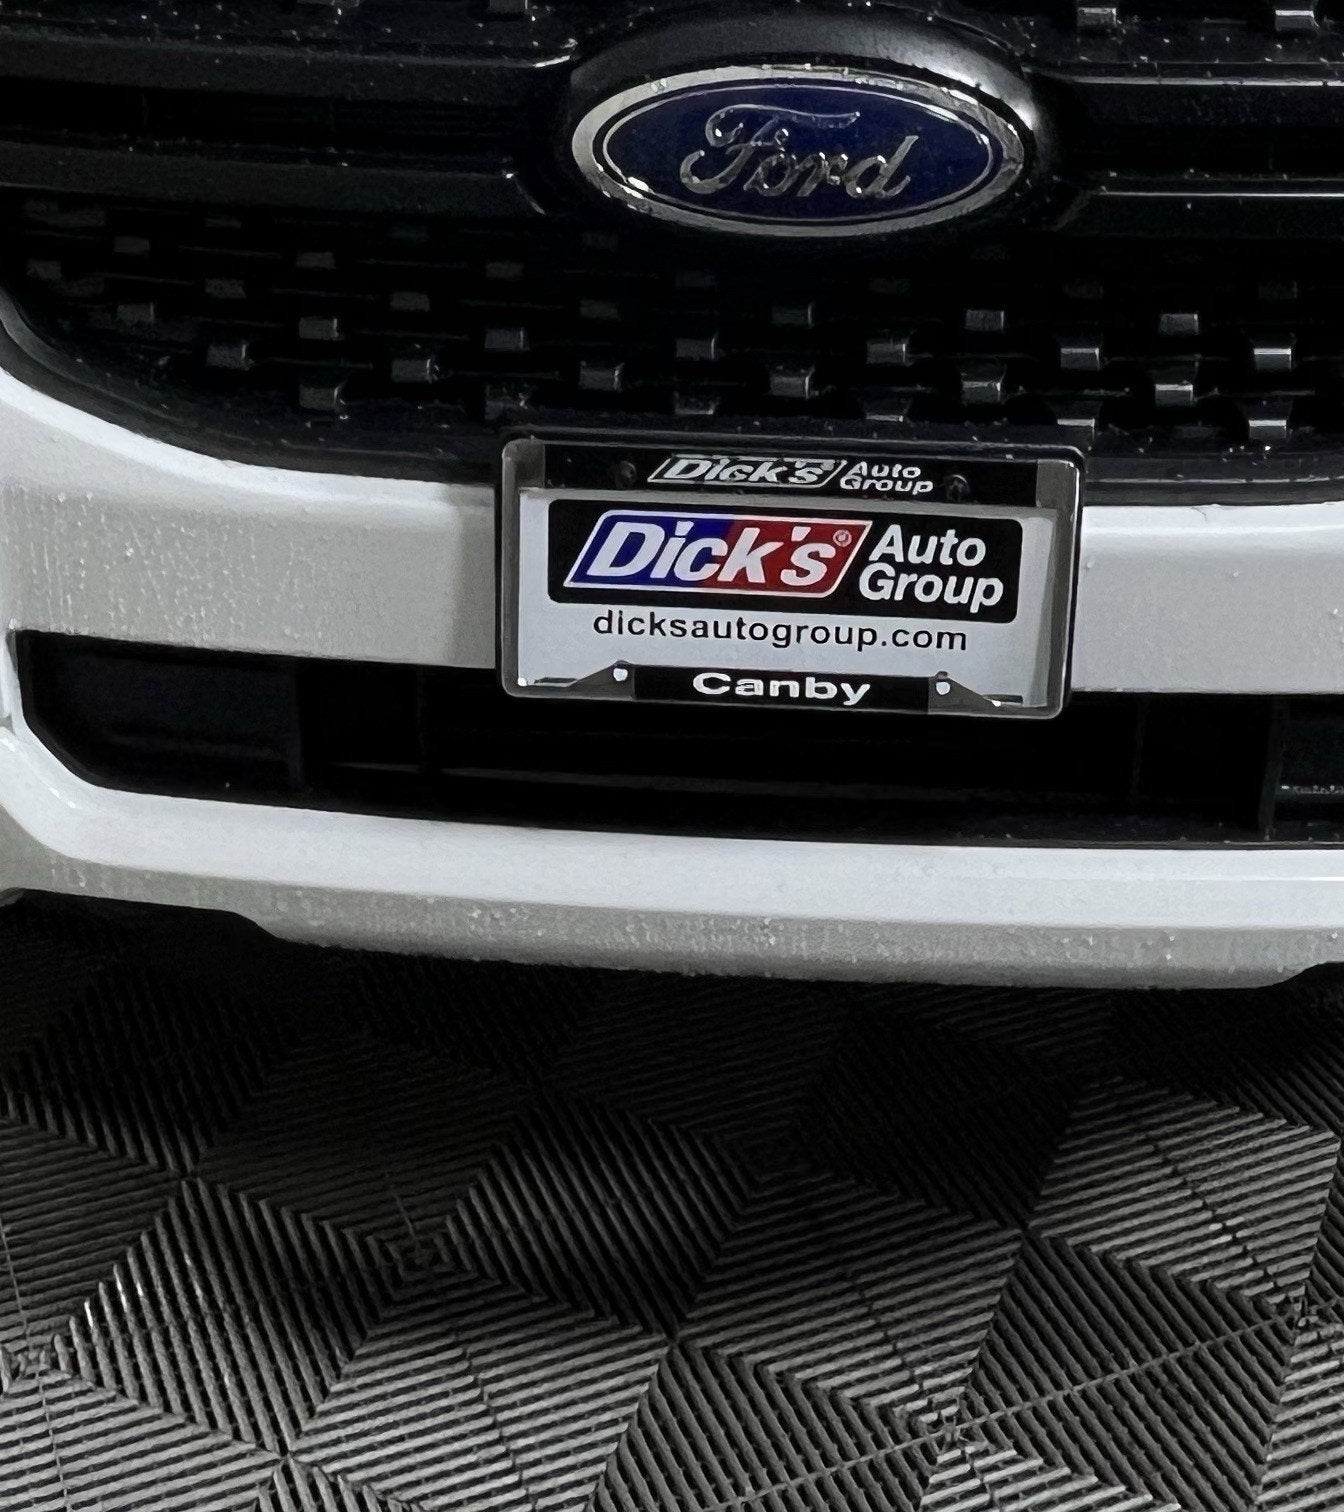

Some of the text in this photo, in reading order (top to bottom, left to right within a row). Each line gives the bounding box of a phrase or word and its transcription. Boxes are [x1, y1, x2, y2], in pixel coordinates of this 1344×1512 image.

[680, 103, 920, 198] Ford
[662, 458, 834, 485] Dick's
[839, 474, 934, 496] Group
[847, 461, 922, 479] Auto
[585, 520, 837, 587] Dick's
[868, 523, 987, 567] Auto
[858, 562, 1005, 614] Group
[592, 609, 968, 652] dicksautogroup.com
[692, 672, 872, 706] Canby
